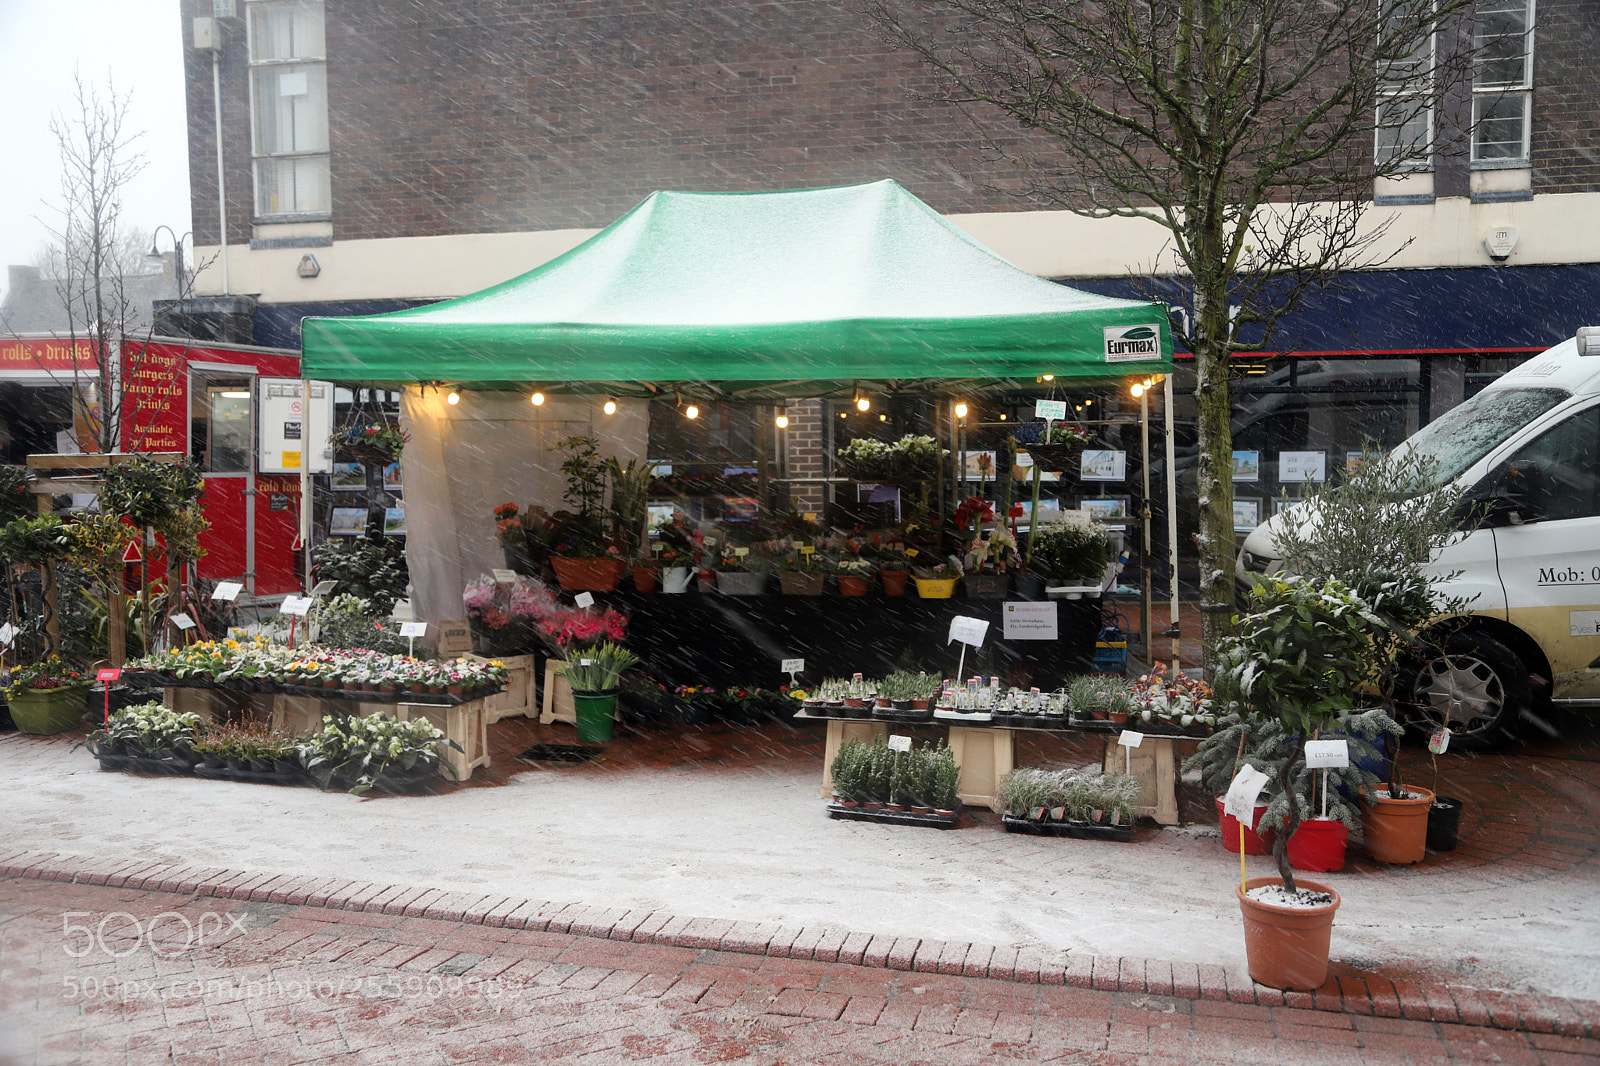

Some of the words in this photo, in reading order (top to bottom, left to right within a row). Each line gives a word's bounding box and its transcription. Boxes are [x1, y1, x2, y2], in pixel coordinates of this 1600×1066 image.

[3, 343, 33, 360] rolls
[46, 342, 91, 360] drinks
[1107, 339, 1155, 354] Eurmax
[151, 353, 177, 368] dogs
[158, 385, 183, 396] rolls
[145, 437, 177, 449] Parties
[259, 481, 279, 492] cold
[1537, 566, 1584, 583] Mob:
